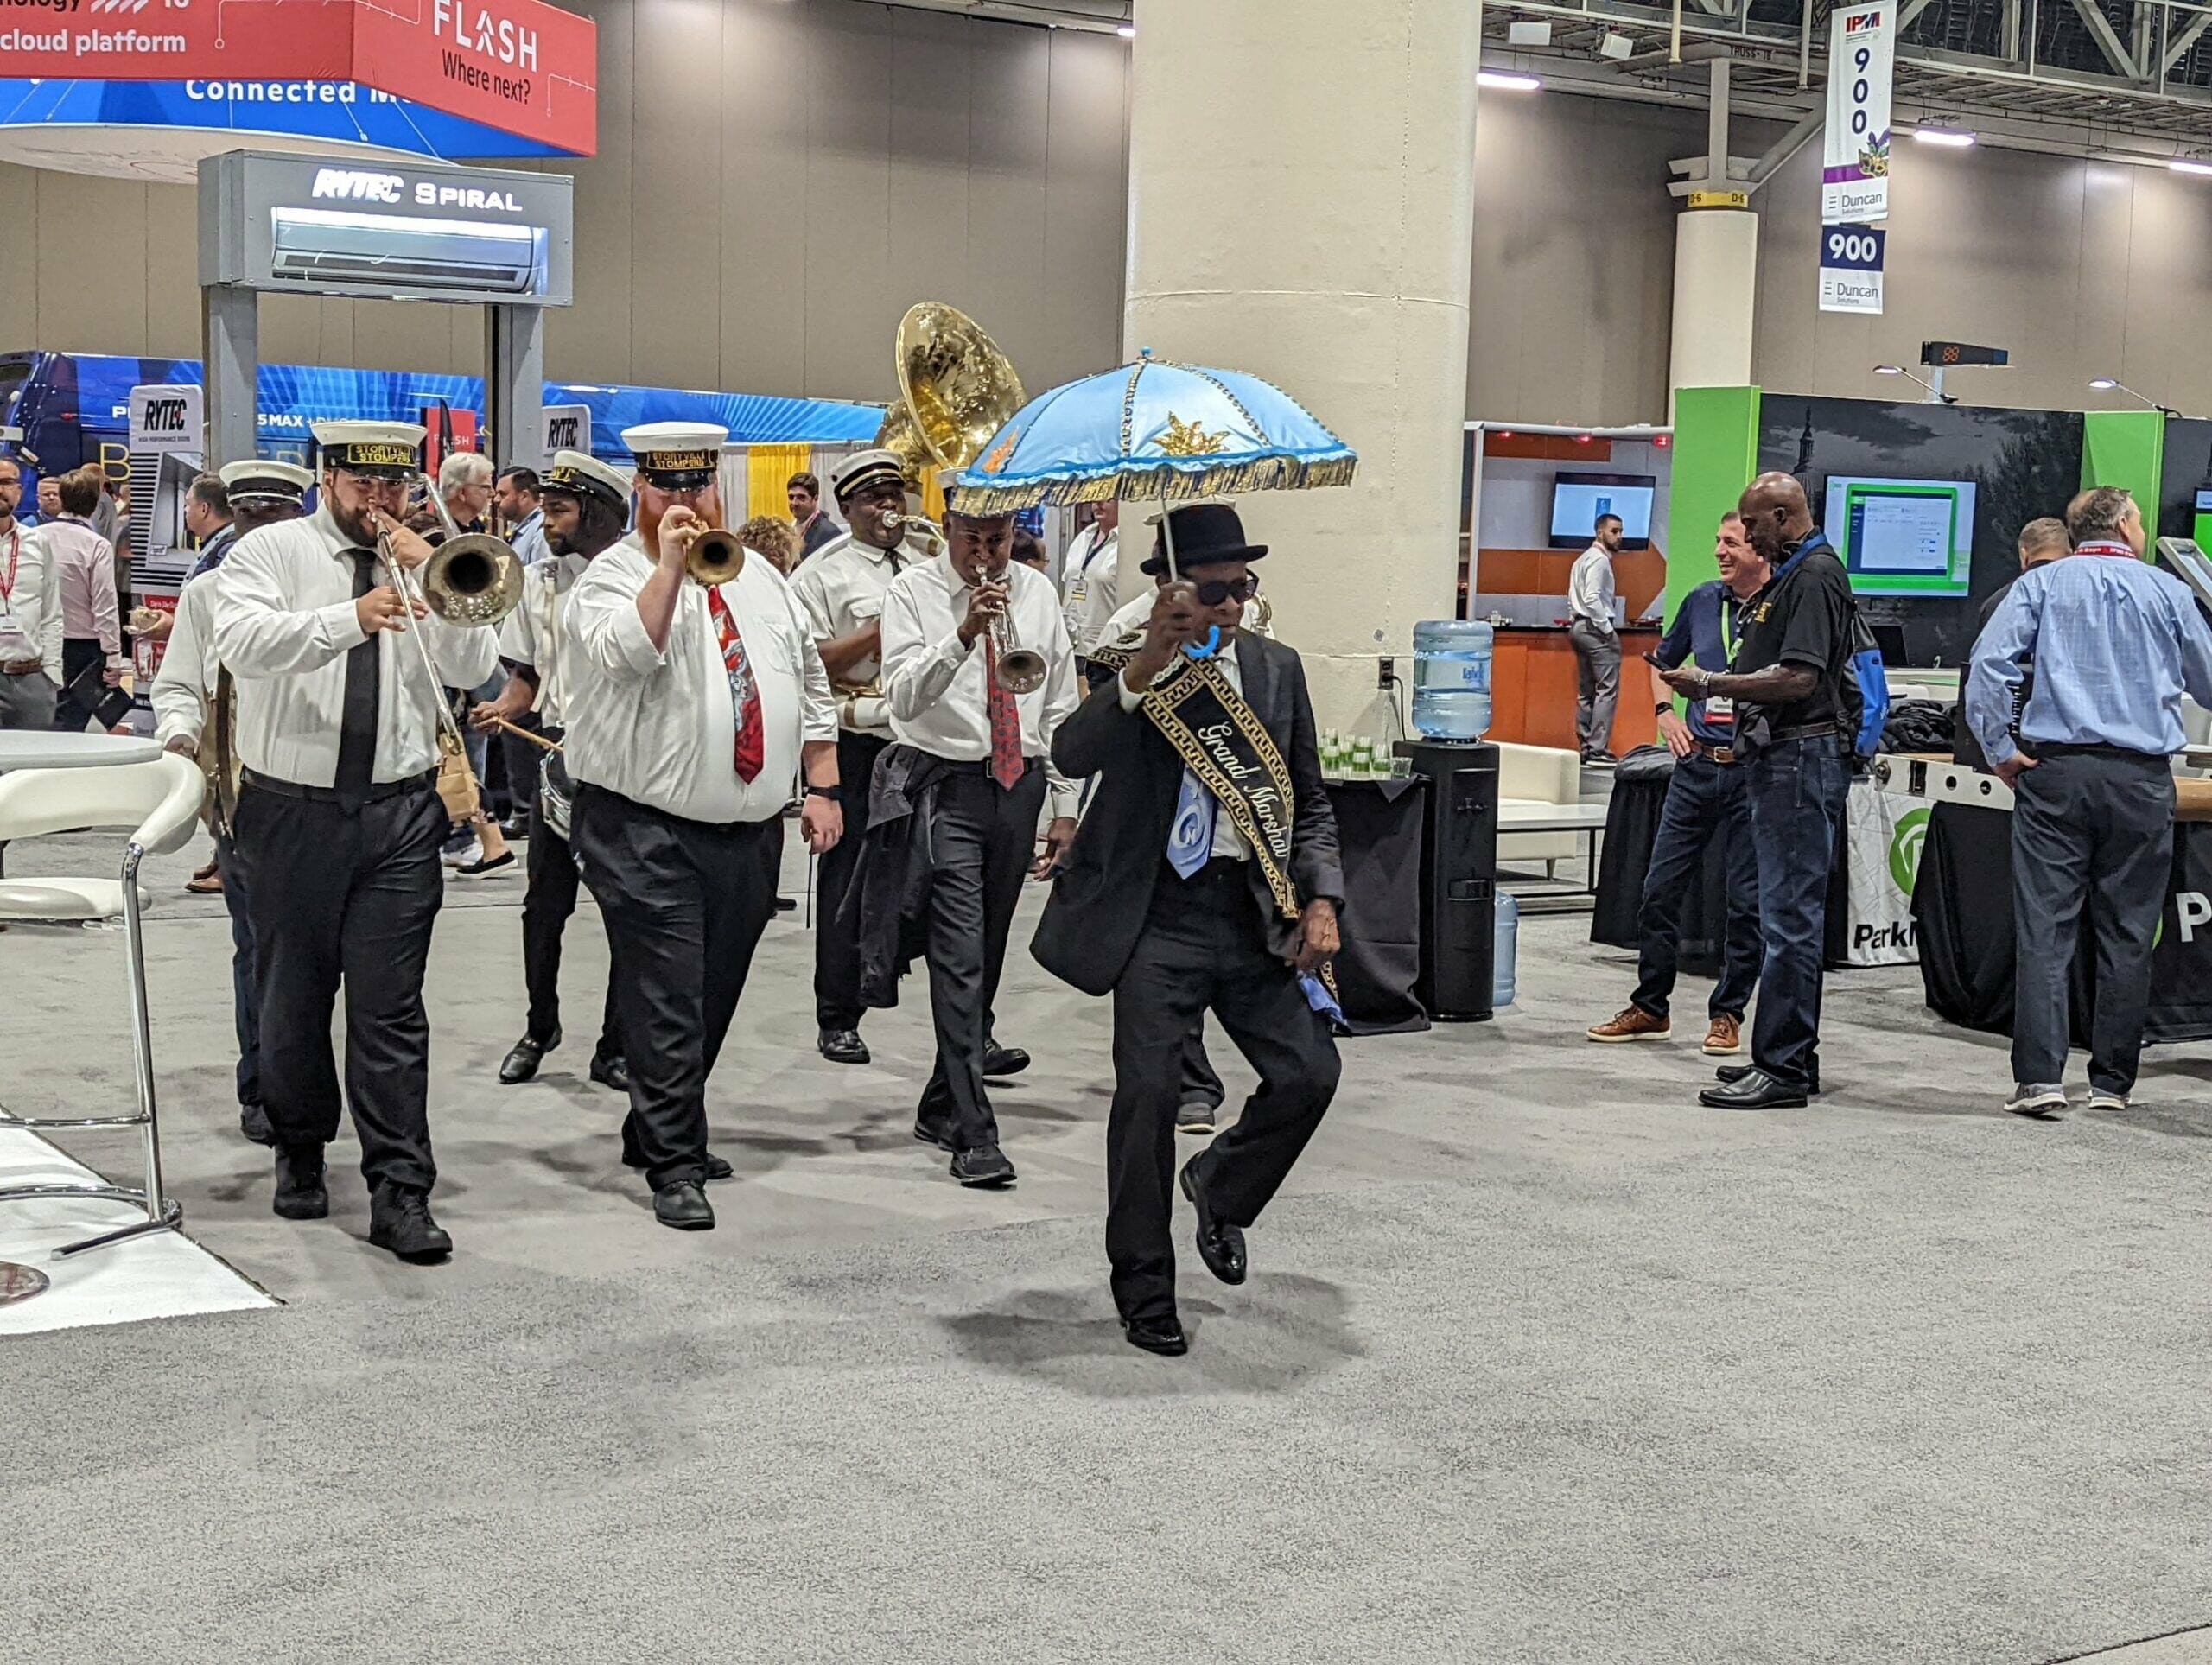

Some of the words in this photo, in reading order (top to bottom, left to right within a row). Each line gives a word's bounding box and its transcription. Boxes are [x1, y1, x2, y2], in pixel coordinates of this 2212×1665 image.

[0, 28, 67, 51] cloud
[75, 29, 186, 56] platform
[434, 0, 537, 73] FLASH
[186, 80, 356, 103] Connected
[442, 49, 489, 92] Where
[493, 73, 531, 105] next?
[415, 182, 523, 211] SPIRAL
[1841, 193, 1882, 207] Duncan
[1828, 233, 1877, 262] 900
[1837, 282, 1878, 299] Duncan
[143, 399, 188, 431] RYTEC
[547, 417, 578, 448] RYTEC
[1198, 721, 1262, 779] Grand
